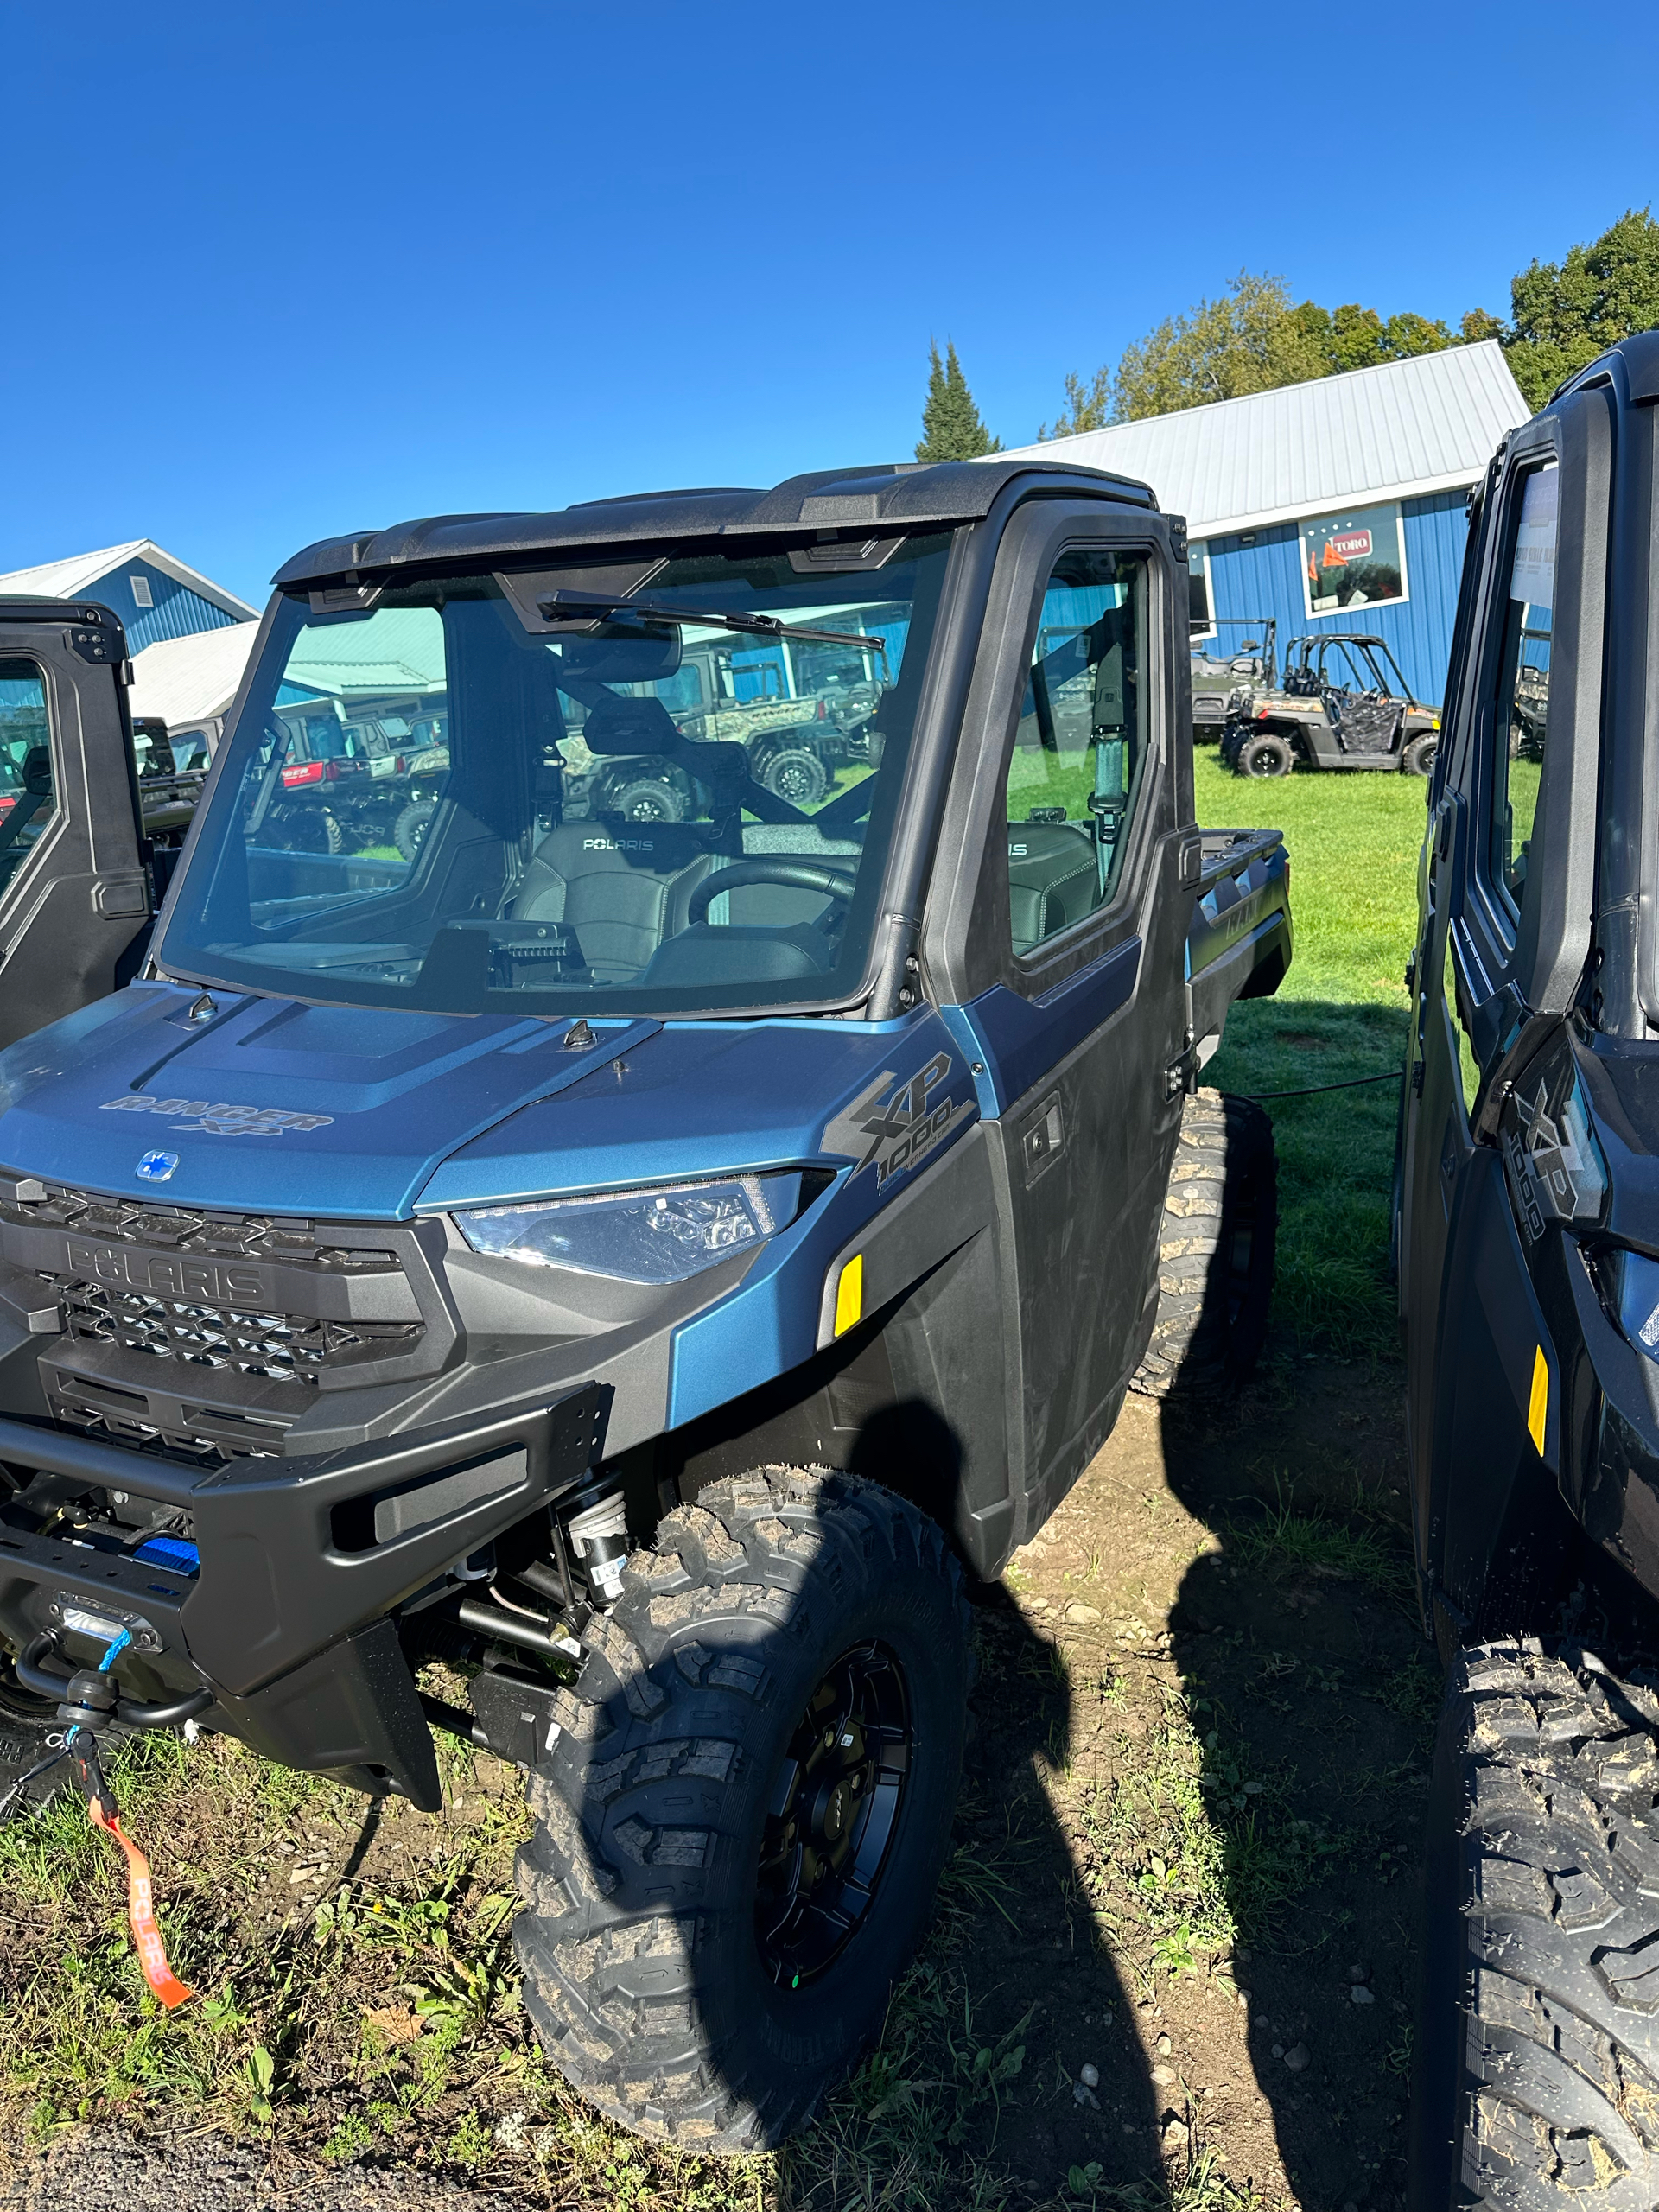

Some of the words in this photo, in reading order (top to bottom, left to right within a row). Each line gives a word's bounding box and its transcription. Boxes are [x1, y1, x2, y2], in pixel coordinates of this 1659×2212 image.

[1334, 538, 1368, 553] TORO
[582, 838, 654, 851] POLARIS
[1007, 843, 1027, 857] IS
[98, 1096, 335, 1132] RANGER
[168, 1117, 284, 1137] XP
[843, 1051, 953, 1190] XP
[877, 1096, 953, 1185] 1000
[1514, 1077, 1579, 1223] XP
[66, 1240, 266, 1303] POLARIS
[134, 1878, 172, 1986] POLARIS
